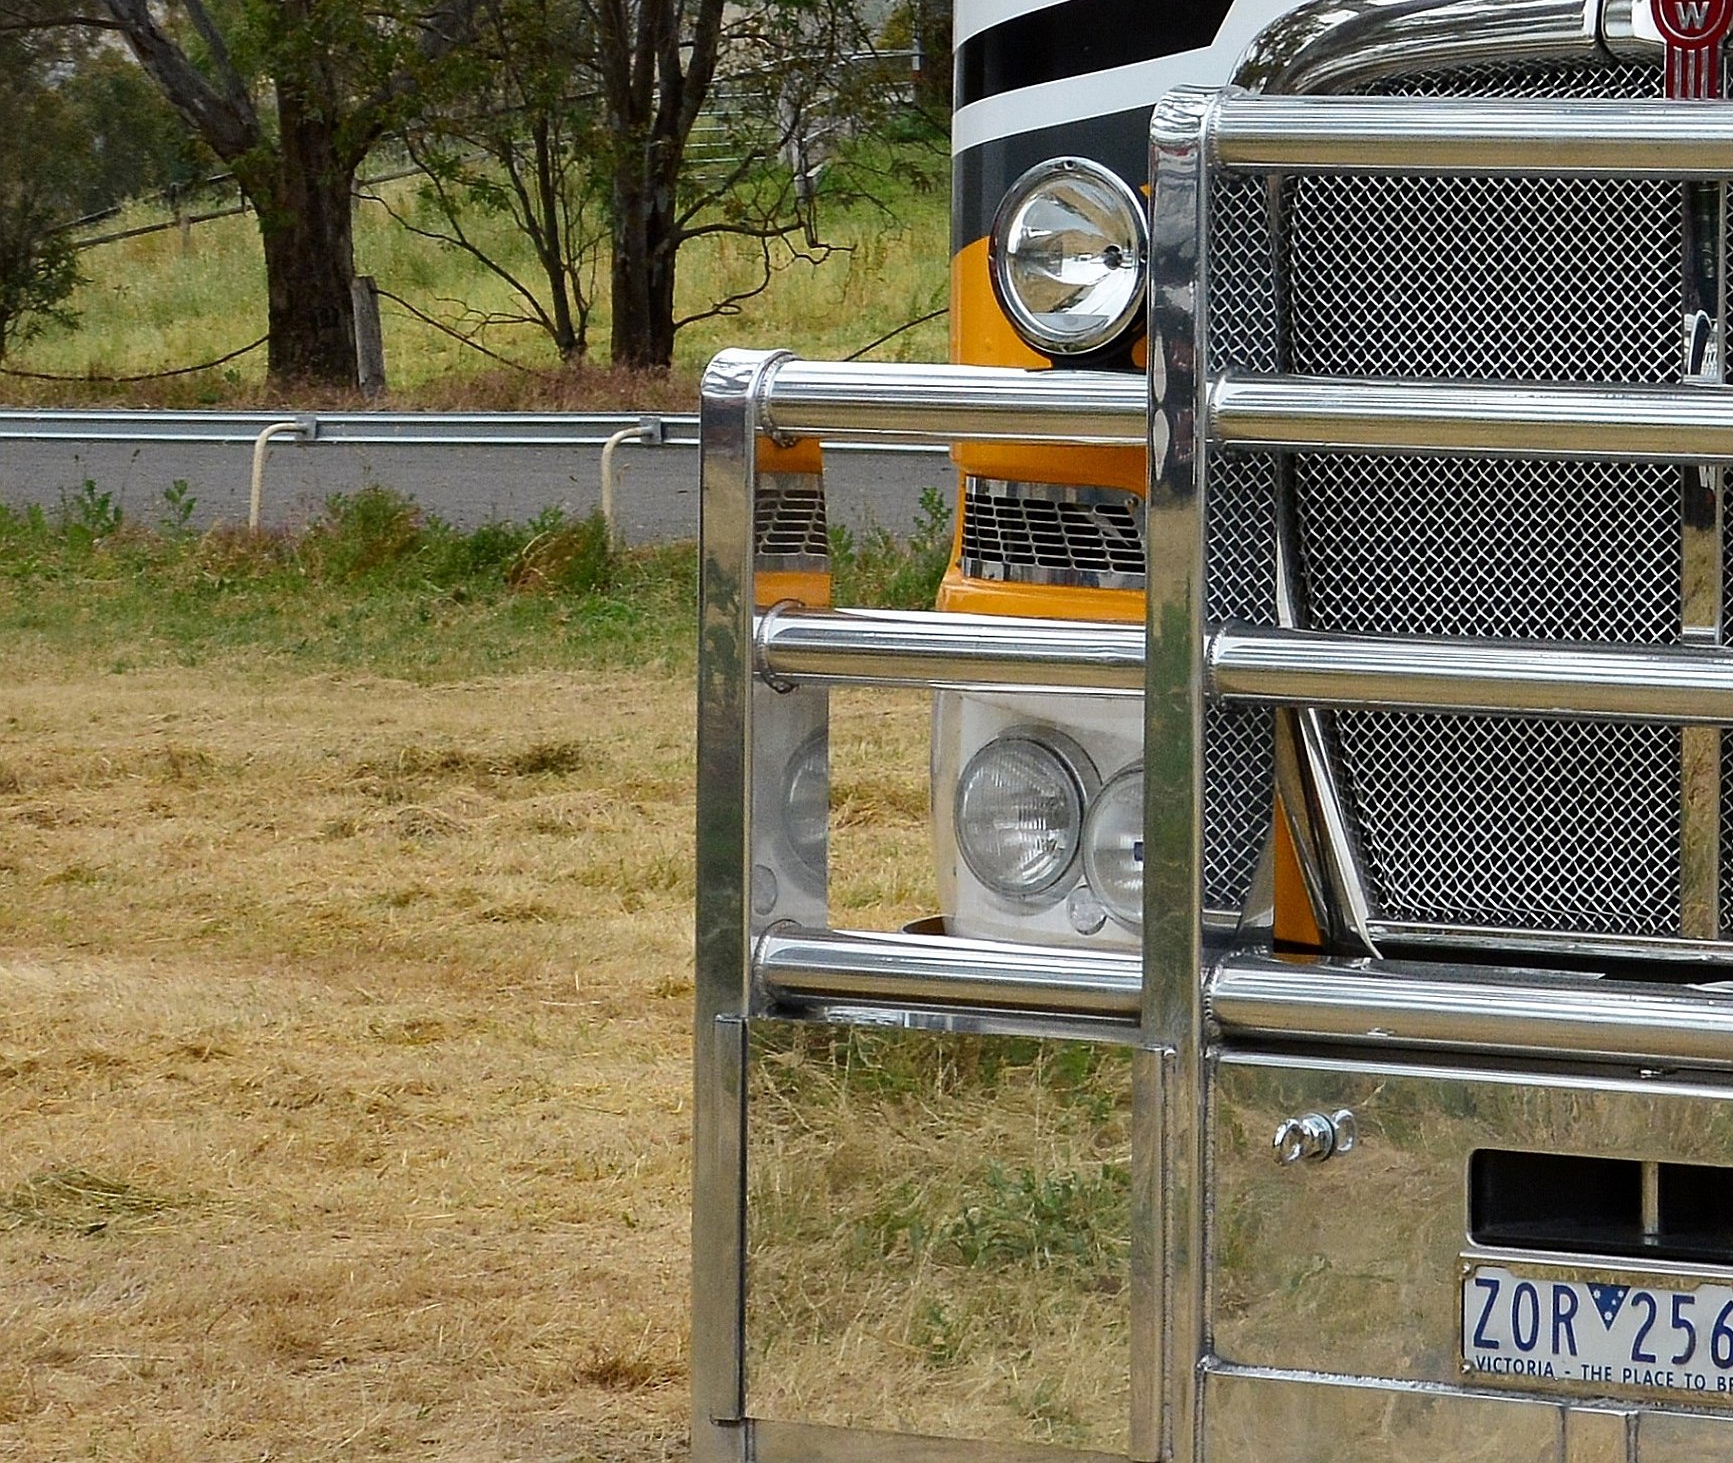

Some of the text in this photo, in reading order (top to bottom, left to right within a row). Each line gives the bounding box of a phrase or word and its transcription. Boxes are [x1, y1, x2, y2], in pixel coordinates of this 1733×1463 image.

[1674, 1, 1710, 30] W
[1473, 1277, 1579, 1357] ZOR
[1475, 1354, 1555, 1378] VICTORIA
[1581, 1364, 1613, 1382] THE
[1623, 1367, 1675, 1388] PLACE
[1684, 1373, 1706, 1389] TO
